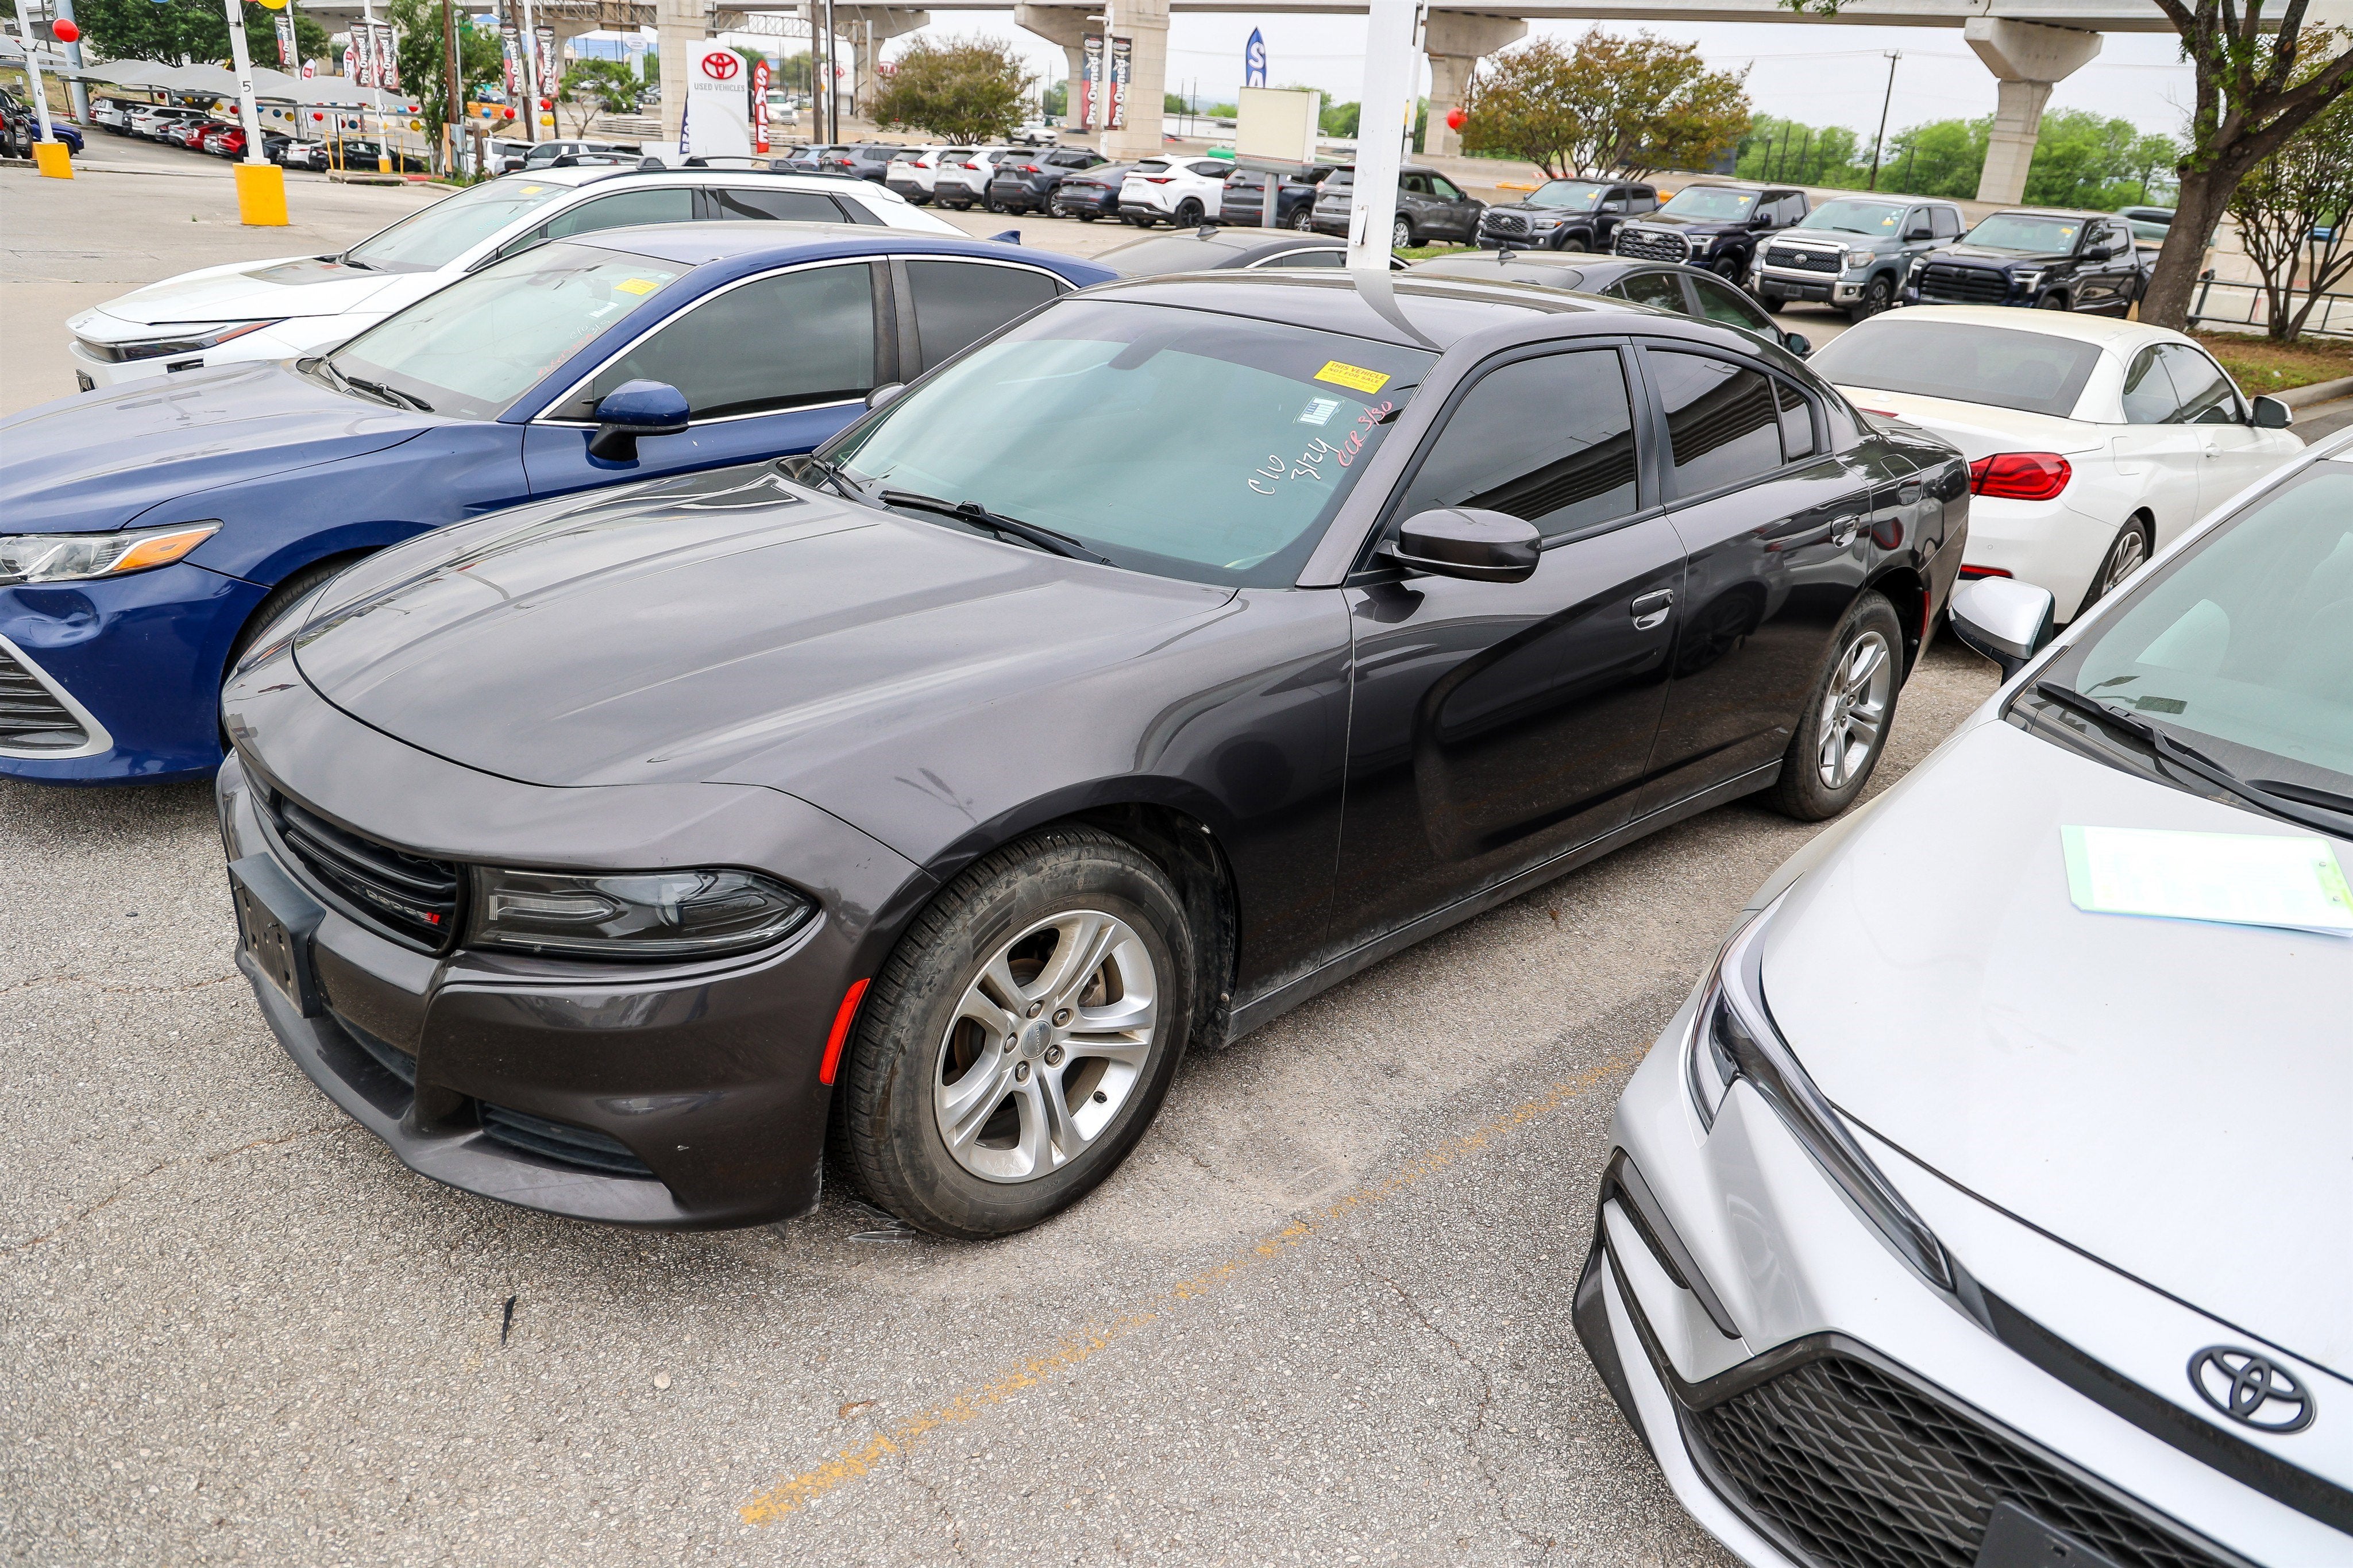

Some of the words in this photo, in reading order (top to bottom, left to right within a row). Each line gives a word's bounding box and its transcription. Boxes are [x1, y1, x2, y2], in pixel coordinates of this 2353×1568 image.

[356, 38, 369, 68] Owned
[379, 39, 392, 69] Owned
[506, 41, 520, 76] Owned
[540, 42, 553, 77] Owned
[242, 80, 251, 92] 5
[360, 68, 370, 85] Pre
[384, 69, 394, 86] Pre
[512, 76, 522, 92] Pre
[543, 78, 553, 94] Pre
[694, 82, 712, 91] USED
[714, 83, 745, 92] VEHICLES
[1087, 56, 1100, 102] Owned
[1113, 59, 1126, 103] Owned
[37, 88, 42, 96] 6
[755, 67, 769, 144] SALE
[1086, 102, 1097, 125] Pre
[1112, 104, 1124, 126] Pre
[1351, 368, 1386, 380] VEHICLE
[1361, 376, 1380, 384] SALE
[366, 889, 431, 921] DODGE
